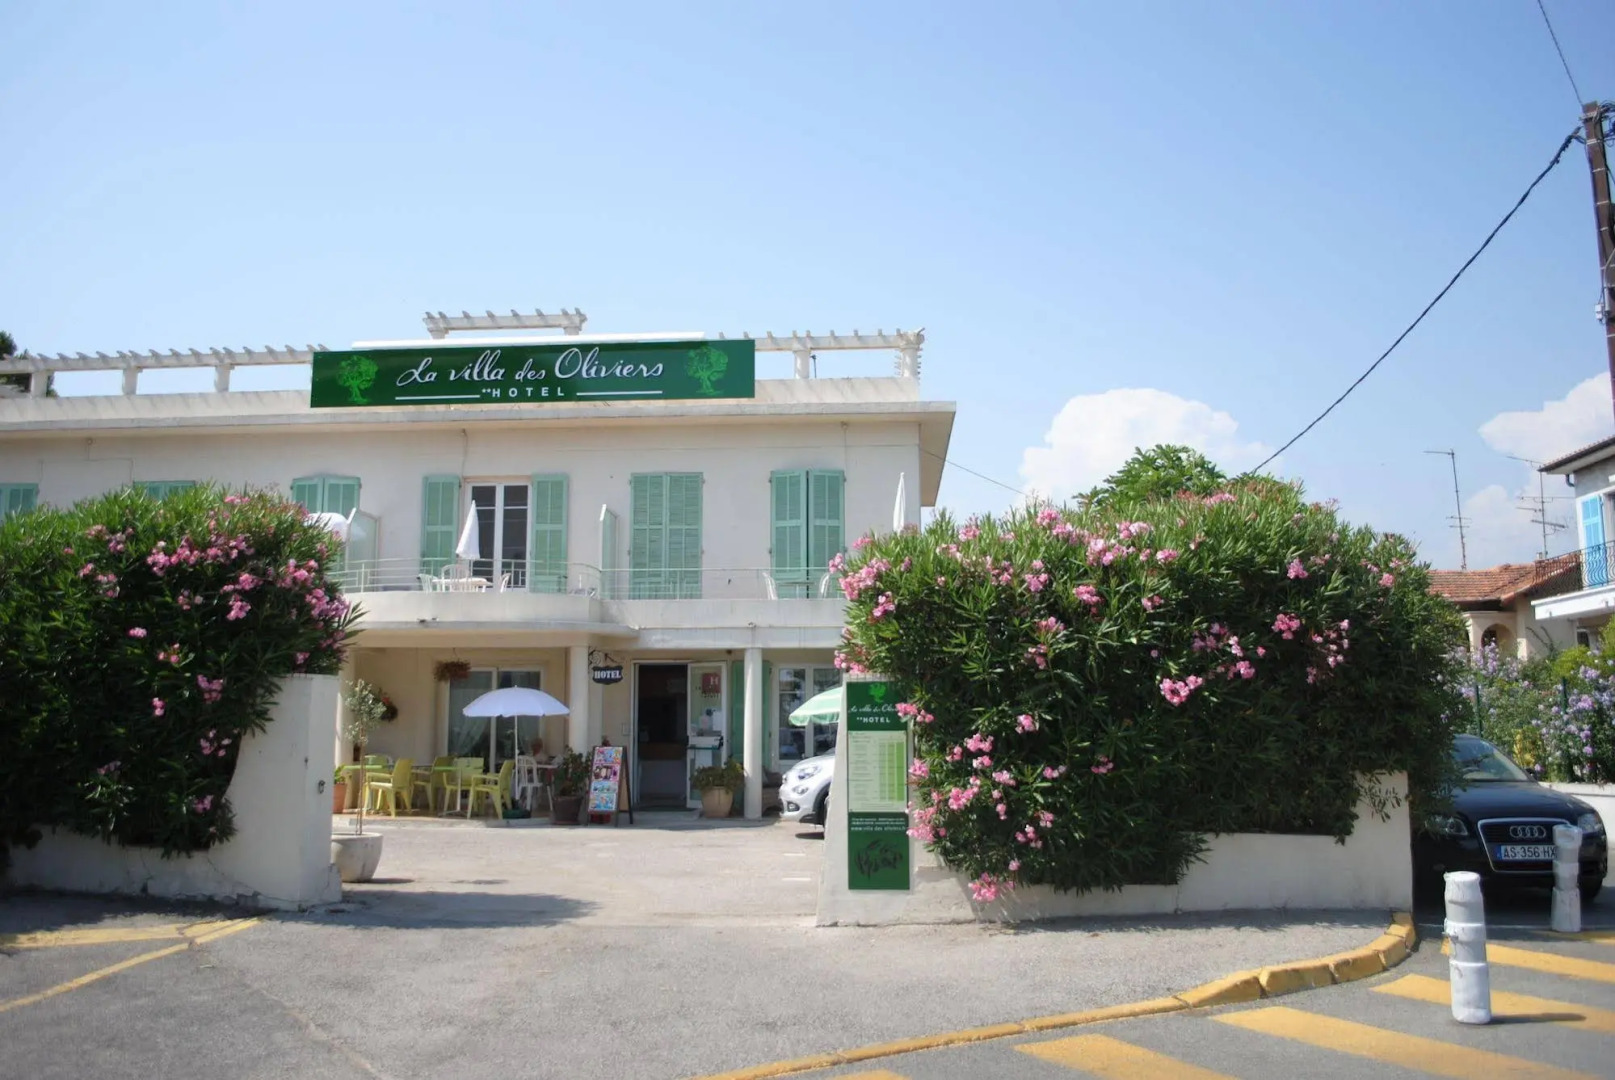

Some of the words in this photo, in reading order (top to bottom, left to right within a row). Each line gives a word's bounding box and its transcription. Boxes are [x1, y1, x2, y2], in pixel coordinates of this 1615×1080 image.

[396, 357, 437, 386] La
[449, 349, 505, 381] villa
[514, 358, 547, 383] des
[554, 346, 664, 379] Oliviers
[594, 670, 621, 679] HOTEL
